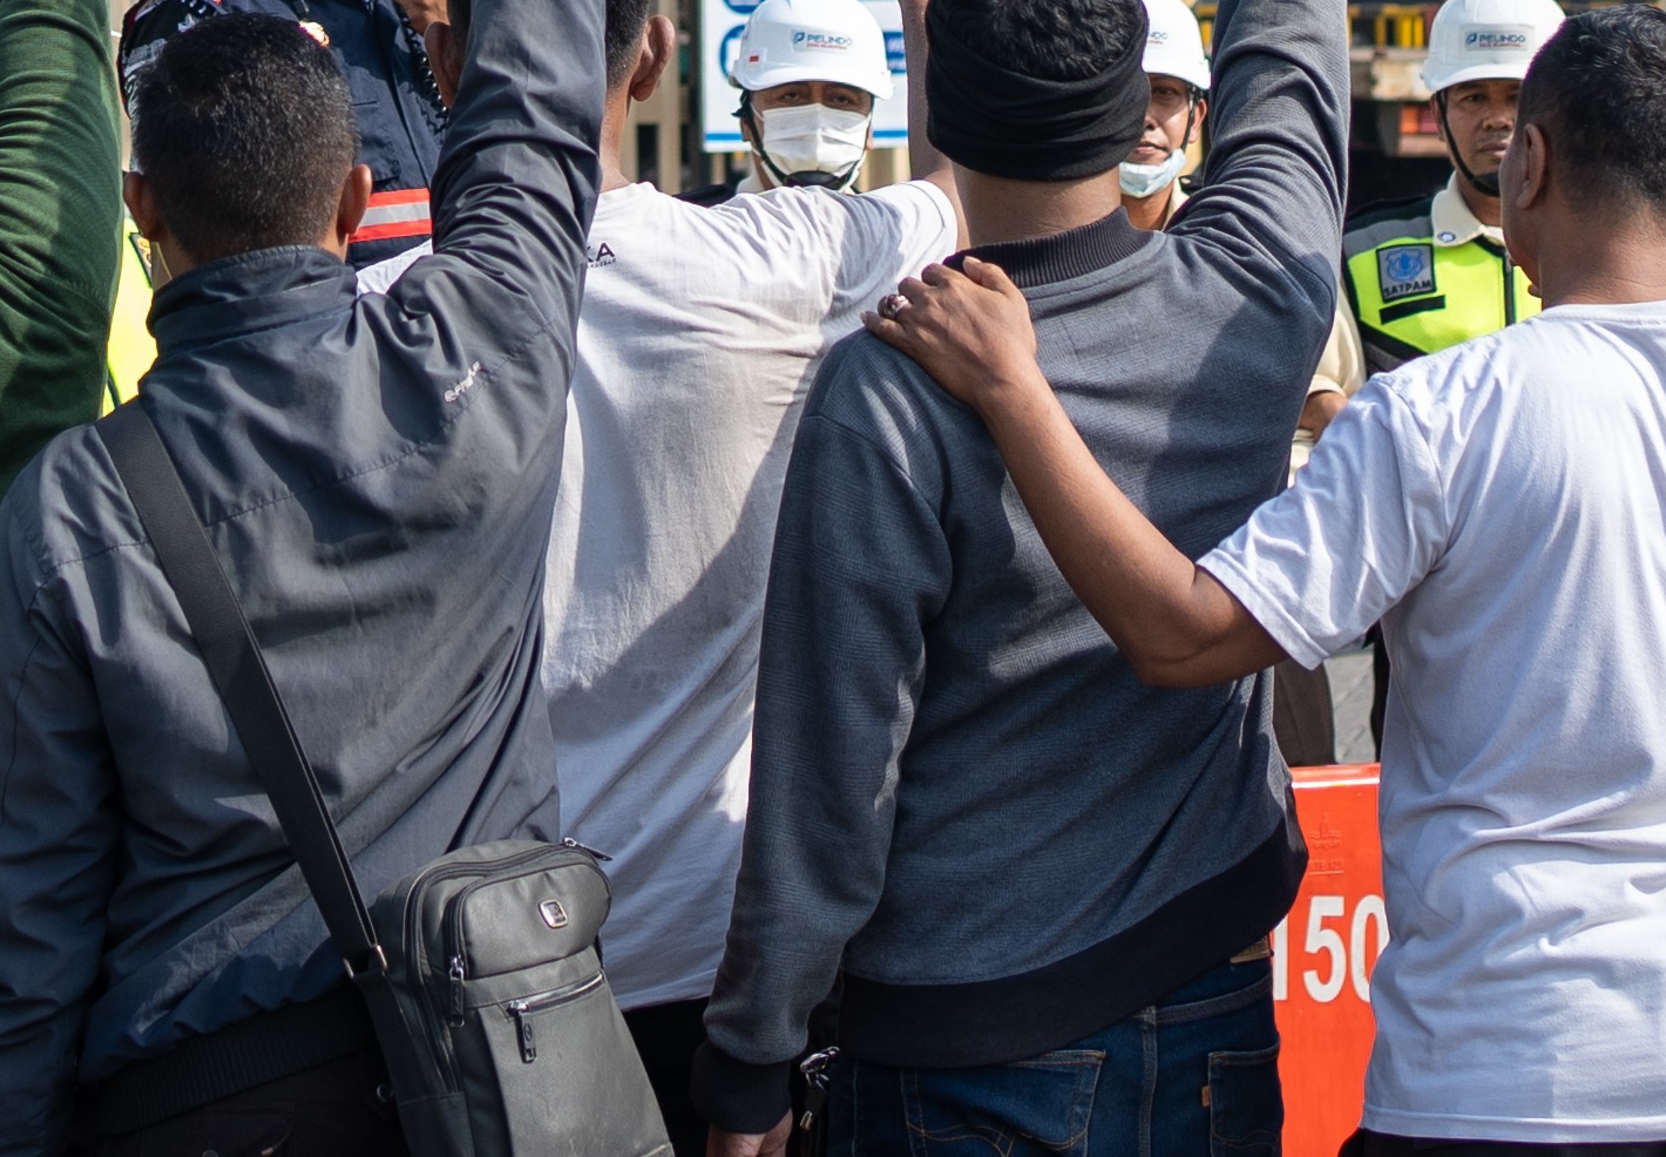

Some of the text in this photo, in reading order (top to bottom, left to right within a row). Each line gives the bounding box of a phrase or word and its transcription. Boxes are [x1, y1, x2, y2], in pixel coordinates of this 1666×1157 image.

[806, 33, 853, 45] PELINDO
[1479, 34, 1526, 43] PELINDO
[1383, 279, 1432, 296] SATPAM
